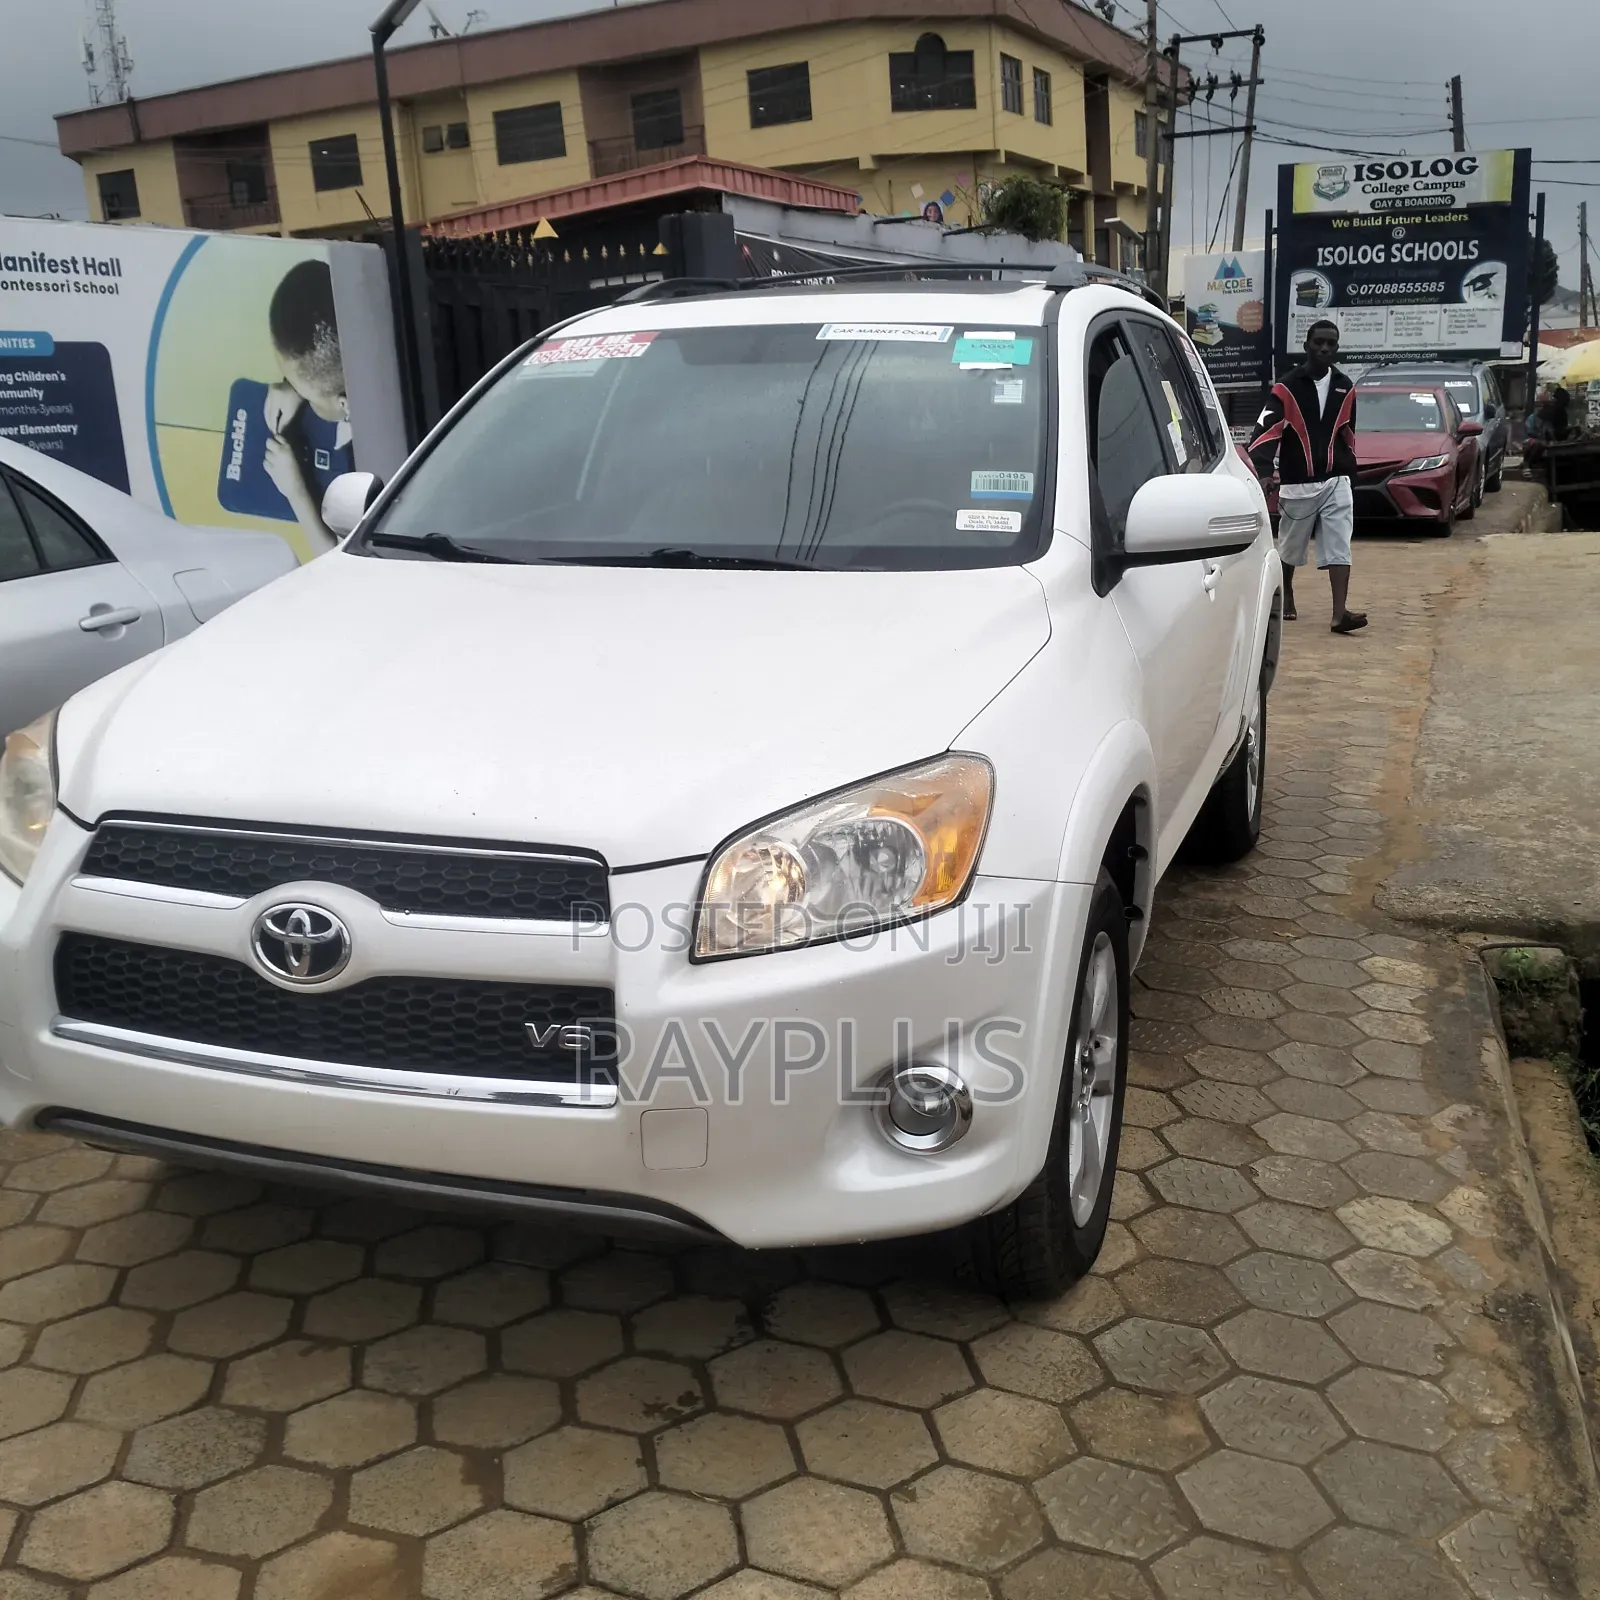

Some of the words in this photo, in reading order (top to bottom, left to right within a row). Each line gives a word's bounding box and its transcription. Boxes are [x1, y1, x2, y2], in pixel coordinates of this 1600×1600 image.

[1353, 157, 1480, 182] ISOLOG
[1362, 182, 1410, 196] College
[1413, 179, 1466, 194] Campus
[1374, 200, 1393, 209] DAY
[1395, 200, 1403, 208] &
[1404, 197, 1452, 207] BOARDING
[1332, 219, 1350, 228] We
[1353, 216, 1382, 227] Build
[1385, 215, 1422, 225] Future
[1425, 213, 1469, 223] Leaders
[1391, 226, 1406, 239] @
[1316, 245, 1386, 266] ISOLOG
[1390, 240, 1480, 263] SCHOOLS
[82, 256, 122, 277] Hall
[0, 278, 71, 293] ontessori
[73, 281, 119, 295] School
[1207, 278, 1253, 291] MACDEE
[1360, 282, 1445, 294] 07088555585
[602, 333, 636, 346] ME
[14, 370, 67, 382] Children's
[19, 423, 78, 436] Elementary
[226, 408, 247, 481] Buckle
[523, 1021, 592, 1051] V6
